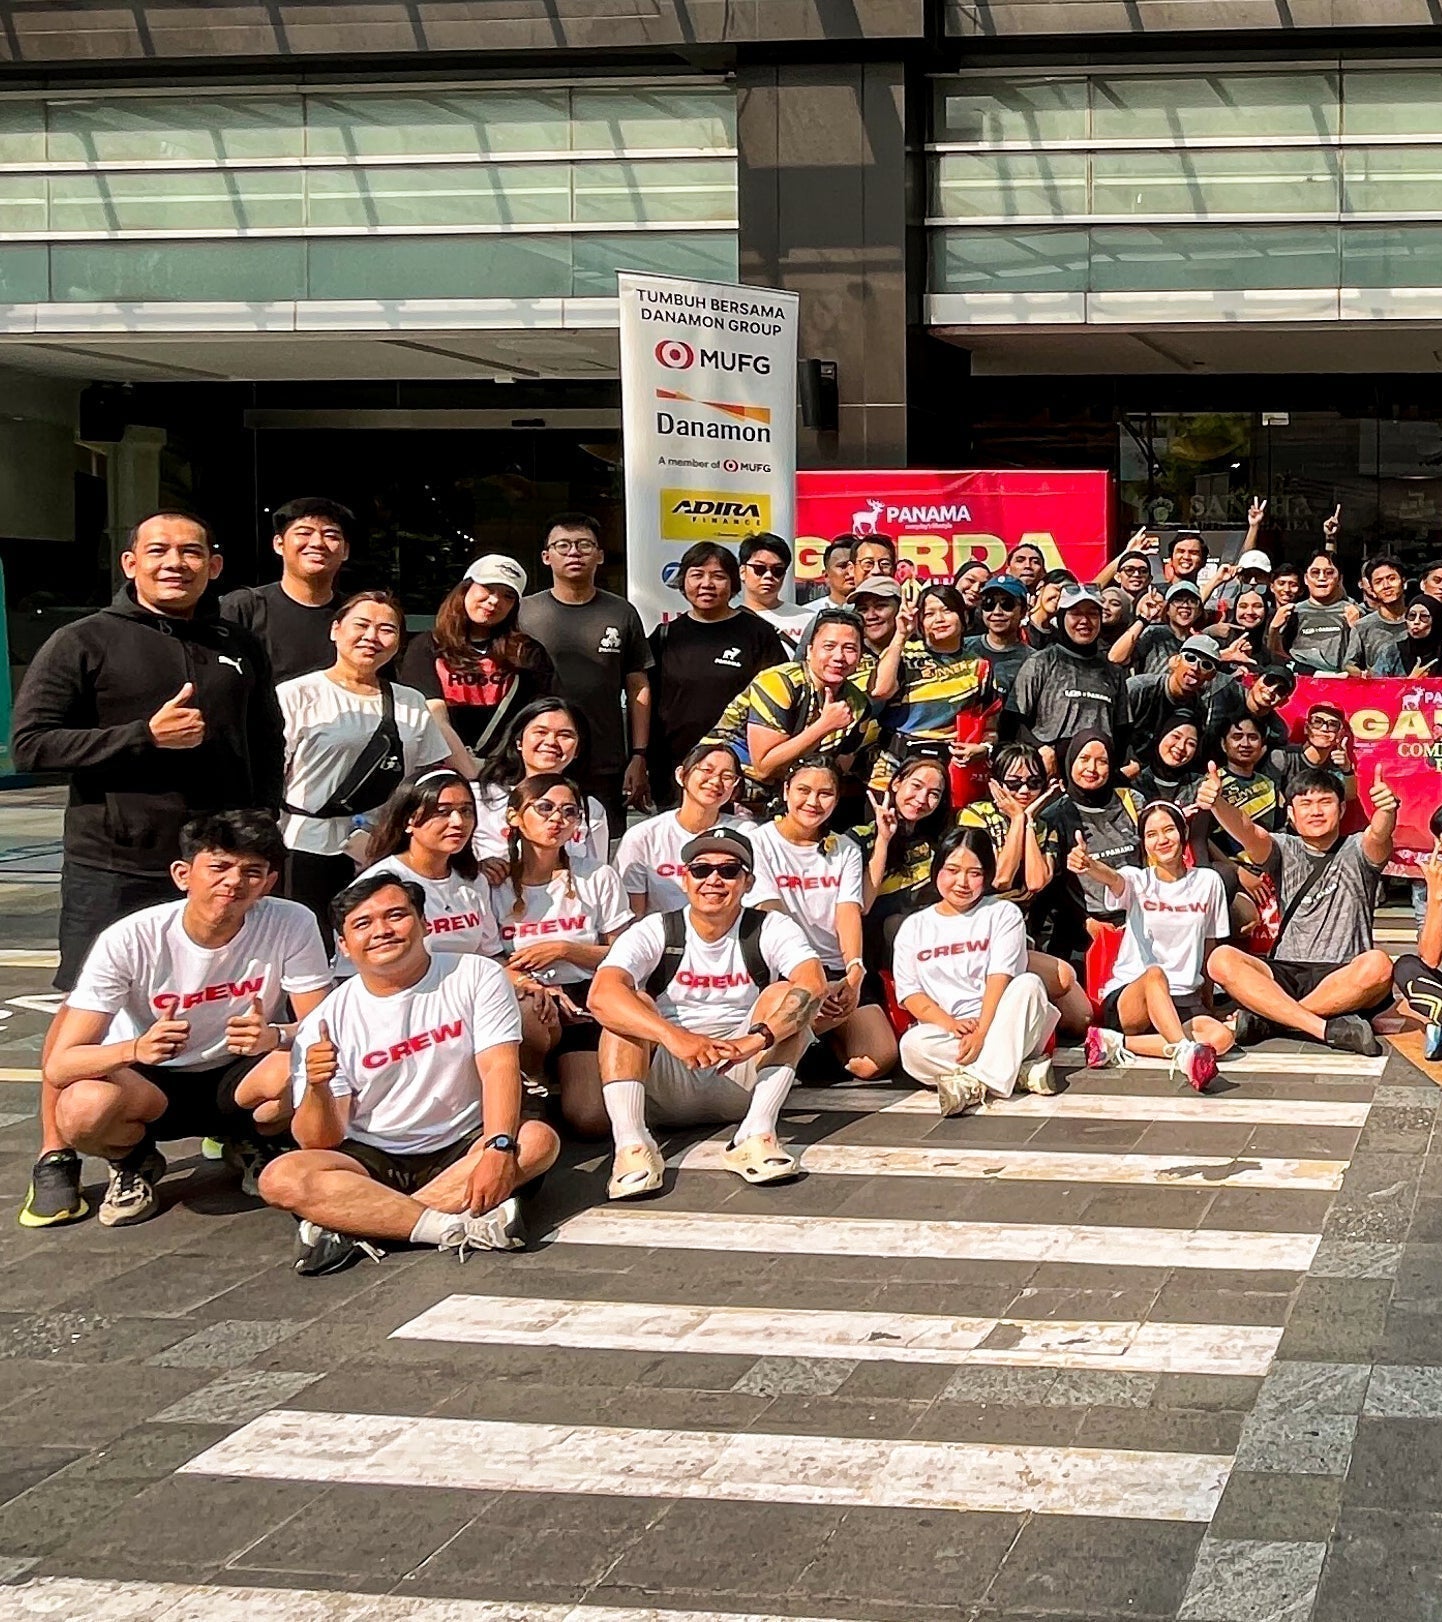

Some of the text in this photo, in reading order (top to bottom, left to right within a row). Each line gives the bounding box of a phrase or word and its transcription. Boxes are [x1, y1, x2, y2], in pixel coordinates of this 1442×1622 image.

[636, 288, 786, 320] TUMBUH BERSAMA
[641, 308, 782, 336] DANAMON GROUP
[700, 348, 771, 375] MUFG
[657, 412, 771, 443] Danamon
[658, 456, 772, 473] A member of MUFG
[672, 500, 760, 518] ADIRA
[692, 517, 761, 526] FINANCE
[886, 504, 972, 524] PANAMA
[794, 532, 1068, 580] GRDA
[775, 875, 842, 891] CREW
[1143, 899, 1209, 915] CREW
[501, 914, 587, 941] CREW
[916, 937, 990, 962] CREW
[153, 975, 266, 1010] CREW
[675, 970, 753, 990] CREW
[362, 1019, 463, 1069] CREW
